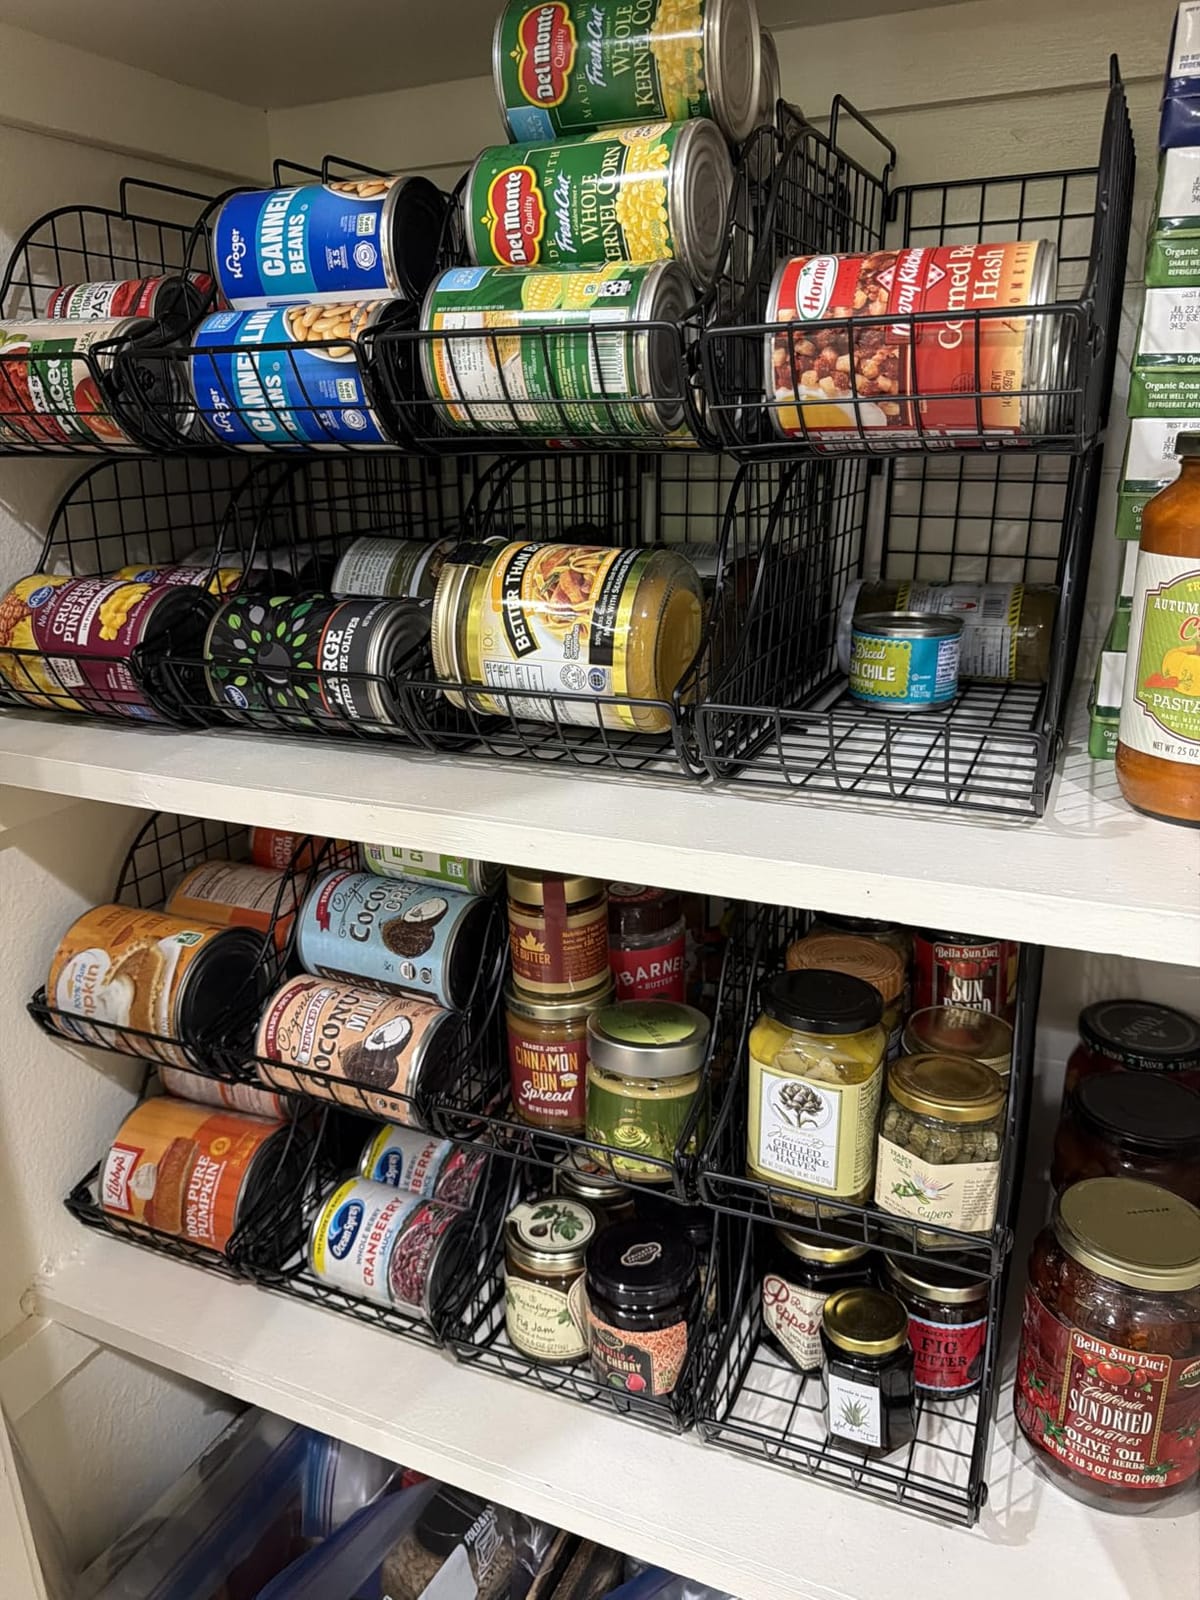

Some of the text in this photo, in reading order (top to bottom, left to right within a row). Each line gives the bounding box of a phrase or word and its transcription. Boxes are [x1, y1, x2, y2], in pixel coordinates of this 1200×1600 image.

[534, 7, 556, 99] Del Monte
[553, 28, 566, 68] Quality
[585, 4, 607, 87] Fresh Cut
[612, 5, 634, 77] WHOLE
[631, 0, 656, 107] KERNEL CO
[576, 72, 592, 119] MADE
[544, 149, 561, 187] WITH
[596, 146, 621, 193] CORN
[505, 172, 528, 262] Del Monte
[524, 196, 536, 235] Quality
[553, 169, 577, 253] Fresh Cut
[580, 173, 599, 244] WHOLE
[225, 228, 247, 279] Kroger
[288, 214, 307, 275] BEANS
[1165, 247, 1199, 259] Organic
[803, 258, 830, 311] Hormel
[973, 249, 1005, 302] Hash
[1177, 355, 1200, 365] To Ope
[1145, 382, 1200, 391] Organic Roas
[1187, 401, 1200, 409] AFT
[505, 553, 532, 586] THAN
[53, 579, 90, 635] CRUSHE
[607, 596, 618, 613] WITH
[1154, 598, 1200, 615] AUTUM
[341, 617, 360, 653] OLIVES
[856, 643, 887, 660] Diced
[862, 663, 896, 682] CHILE
[1152, 740, 1164, 751] NET
[1177, 746, 1188, 756] 25
[1188, 747, 1200, 758] OZ
[349, 880, 397, 942] COCON
[384, 882, 420, 911] CRE
[520, 950, 551, 965] BUTTER
[935, 947, 999, 959] Bella Sun Luci
[619, 957, 684, 986] BARNE
[951, 976, 983, 1001] SUN
[515, 1046, 579, 1072] CINNAMON
[522, 1042, 544, 1052] TRADER
[520, 1080, 575, 1103] Spread
[532, 1071, 558, 1091] BUN
[766, 1143, 830, 1168] ARTICHOKE
[773, 1138, 822, 1158] GRILLED
[776, 1152, 817, 1172] HALVES
[107, 1155, 126, 1201] Libby's
[186, 1154, 211, 1238] 100% PURE
[199, 1162, 220, 1238] PUMPKIN
[917, 1206, 954, 1222] Capers
[332, 1205, 361, 1257] Ocean Spray
[356, 1208, 381, 1264] WHOLE BERRY
[363, 1197, 403, 1287] CRANBERRY
[379, 1229, 394, 1256] SAUCE
[516, 1314, 529, 1330] Fig
[531, 1322, 556, 1334] Jam
[917, 1351, 968, 1368] UTTER
[921, 1337, 958, 1355] FIG
[1074, 1333, 1164, 1372] Bella Sun Luci
[606, 1355, 642, 1373] CHERRY
[1075, 1372, 1154, 1402] PREMIUM
[1078, 1381, 1145, 1411] California
[1069, 1388, 1153, 1436] SUN DRIED
[1064, 1426, 1145, 1463] OLIVE OIL
[1074, 1417, 1142, 1447] Tomatoes
[1043, 1435, 1167, 1484] NET WT 2 LB 3 OZ (35 OZ) (992g)
[1071, 1442, 1110, 1464] ITALIAN
[1112, 1459, 1145, 1471] HERBS
[464, 1522, 481, 1547] FOLD
